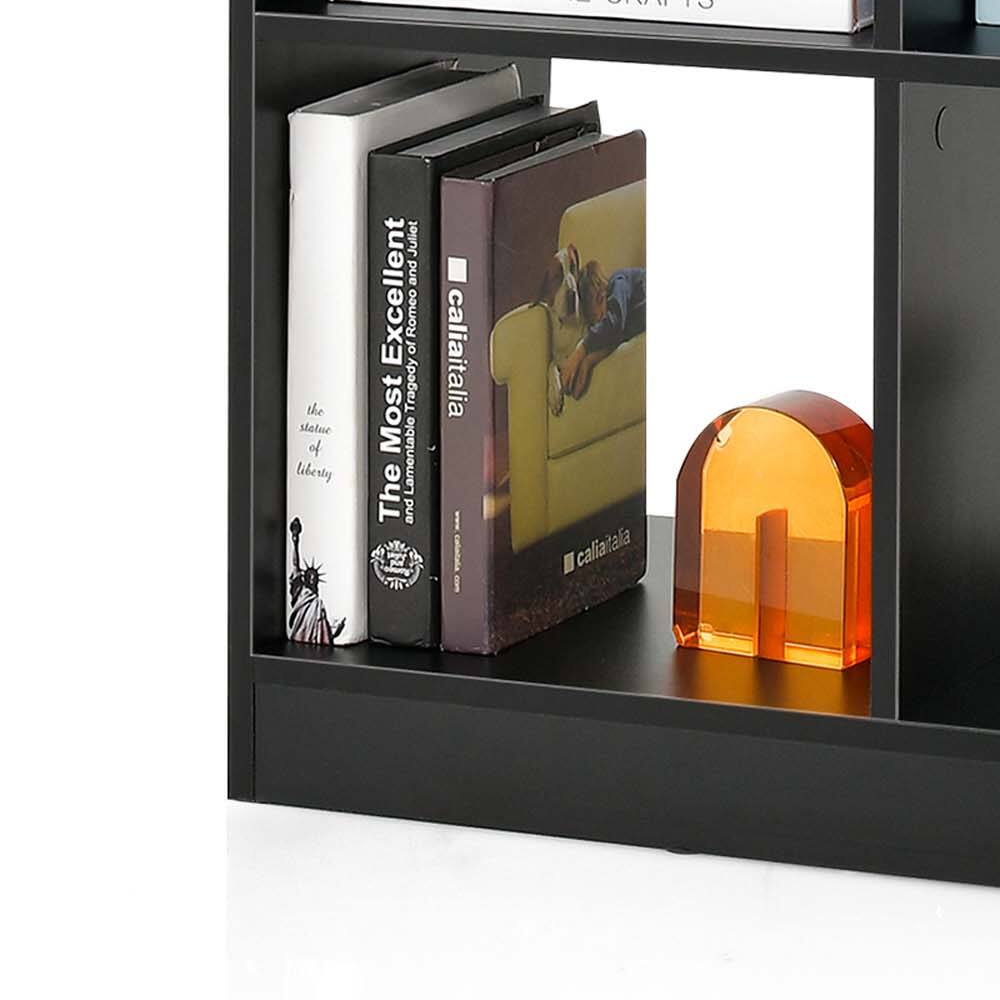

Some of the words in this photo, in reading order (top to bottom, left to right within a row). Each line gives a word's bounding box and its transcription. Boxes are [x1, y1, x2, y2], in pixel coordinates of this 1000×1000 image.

[407, 220, 418, 257] Juliet
[381, 217, 405, 366] Excellent
[407, 260, 417, 286] and
[405, 288, 417, 338] Romeo
[405, 340, 417, 355] of
[448, 288, 468, 419] caliaitalia
[404, 357, 418, 413] Tragedy
[299, 422, 331, 434] statue
[307, 402, 324, 416] the
[380, 374, 403, 453] Most
[309, 439, 322, 457] of
[404, 416, 416, 494] Lamentable
[296, 461, 332, 484] liberty
[378, 463, 401, 523] The
[404, 498, 414, 525] and
[577, 527, 631, 568] caliaitalia
